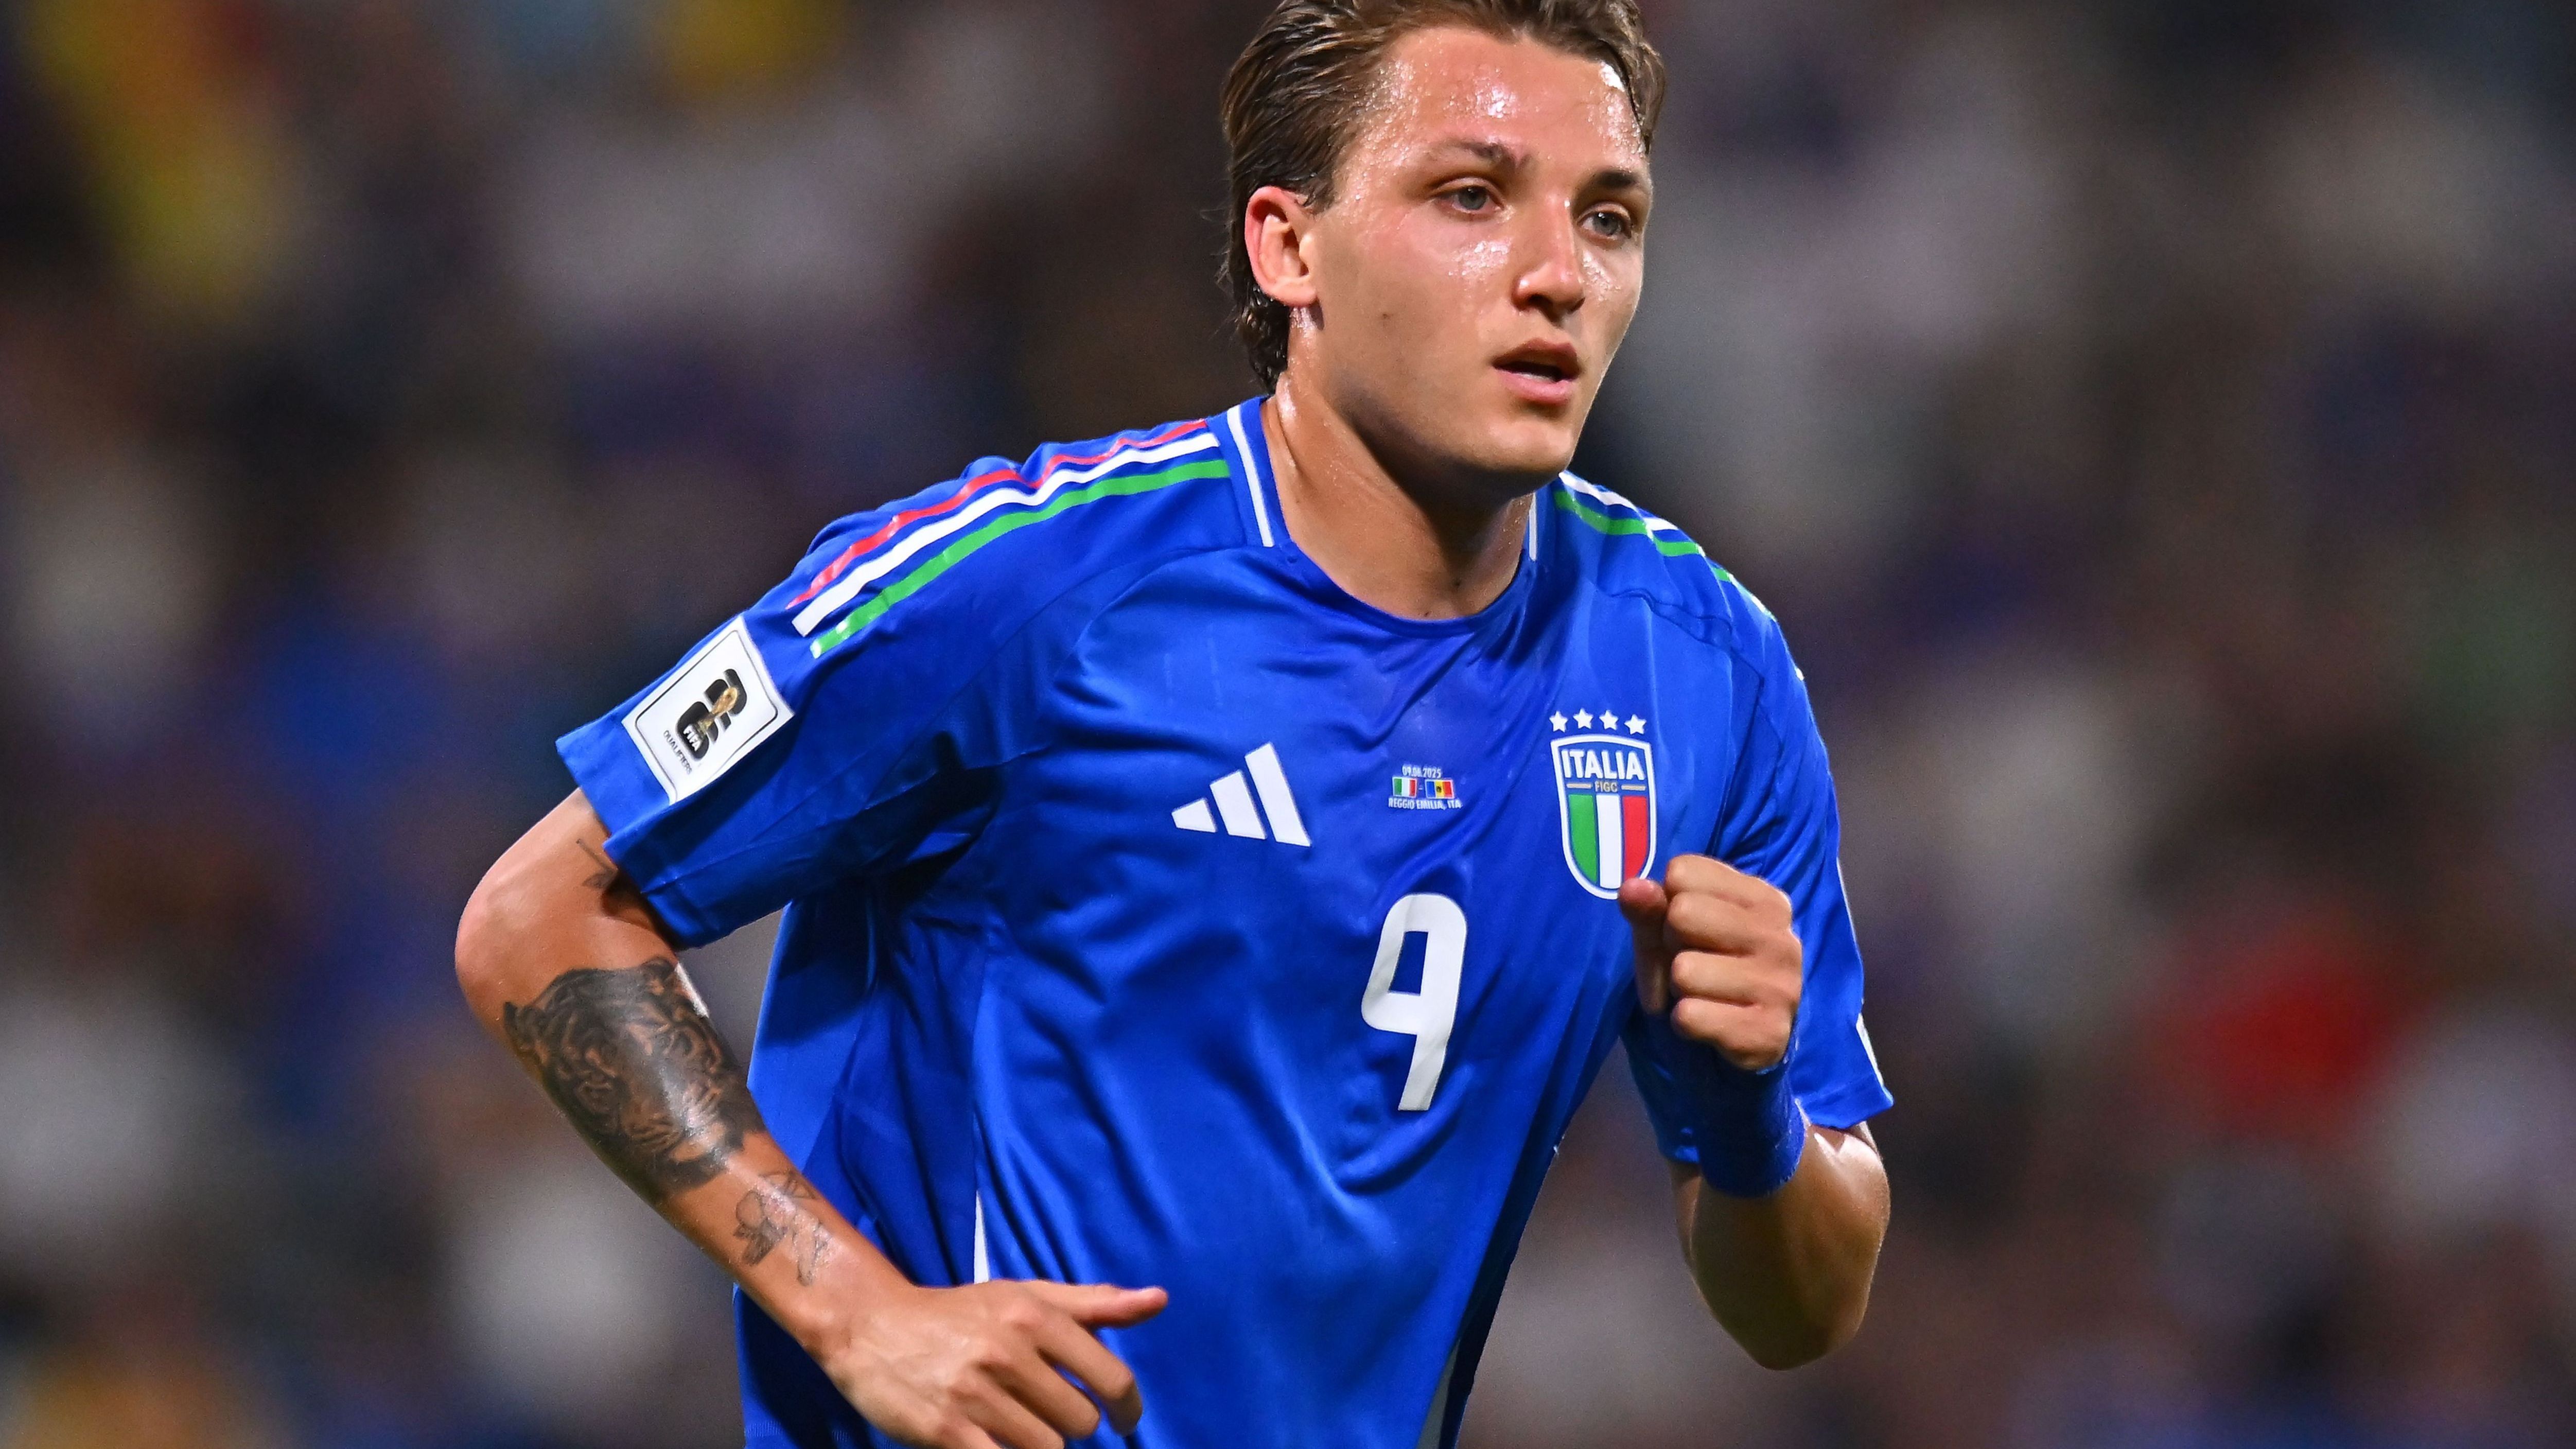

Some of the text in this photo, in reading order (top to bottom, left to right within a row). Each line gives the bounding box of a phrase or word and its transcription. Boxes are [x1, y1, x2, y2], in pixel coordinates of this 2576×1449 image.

[683, 724, 702, 751] FIFA
[663, 730, 692, 774] QUALIFIERS
[1561, 749, 1644, 780] ITALIA
[1402, 766, 1442, 778] 09.06.2025
[1594, 781, 1618, 792] FIGC
[1389, 798, 1462, 810] REGGIO EMILIA, ITA
[1361, 894, 1466, 1111] 9
